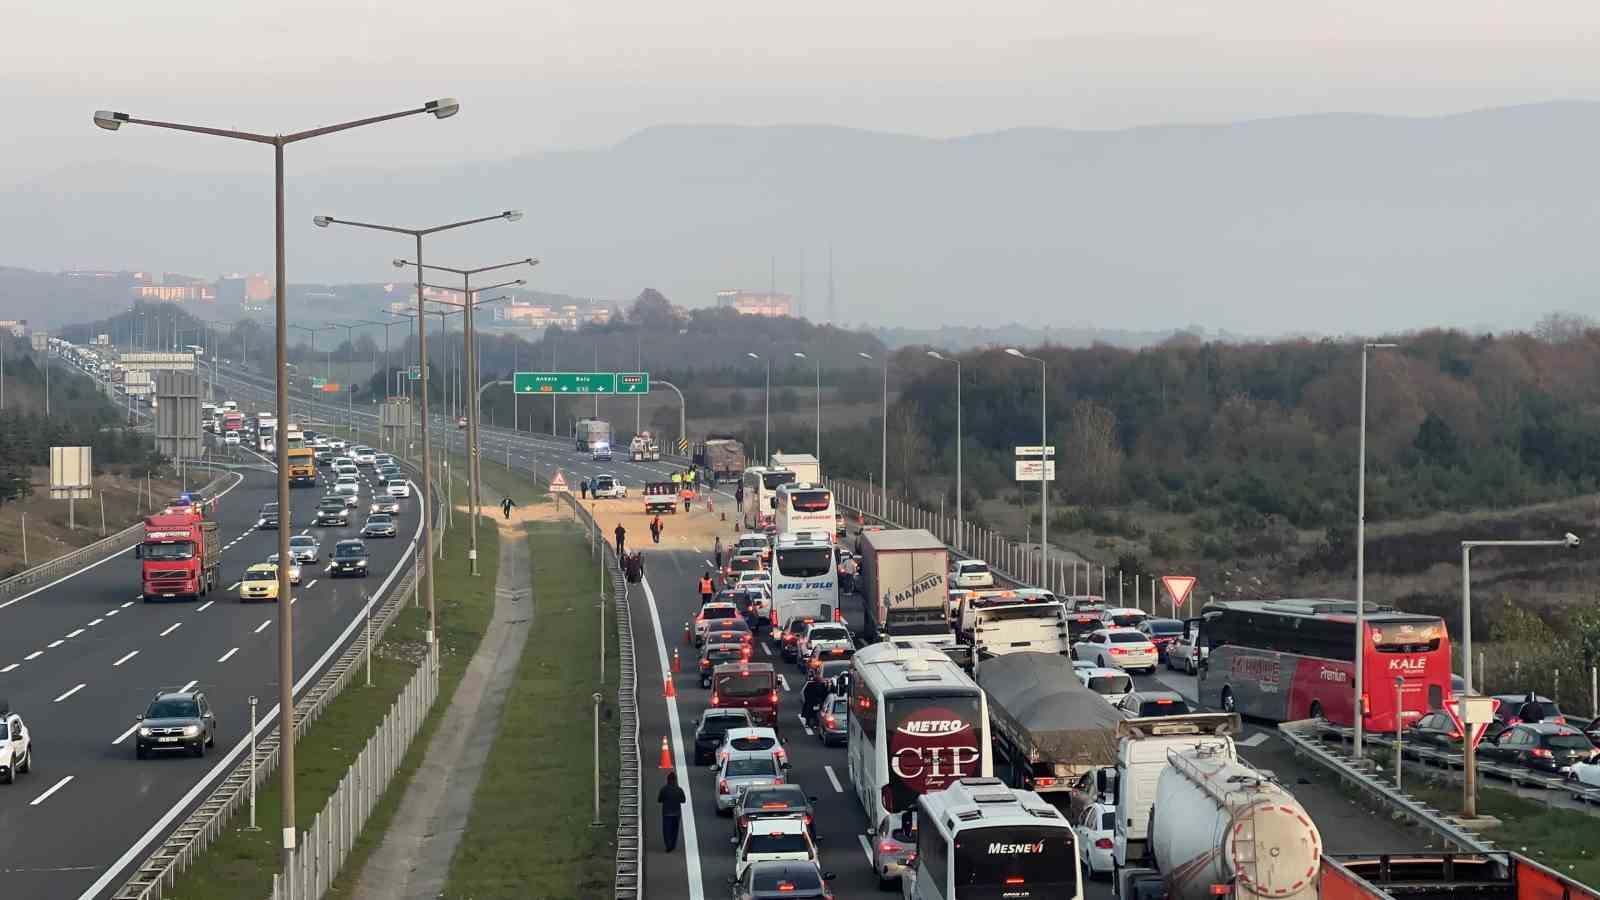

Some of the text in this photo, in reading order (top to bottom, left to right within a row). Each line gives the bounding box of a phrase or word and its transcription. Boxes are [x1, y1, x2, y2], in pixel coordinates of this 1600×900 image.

[895, 575, 943, 604] MAMMUT
[1320, 666, 1346, 682] Premium
[906, 719, 962, 732] METRO
[891, 746, 980, 778] CIP
